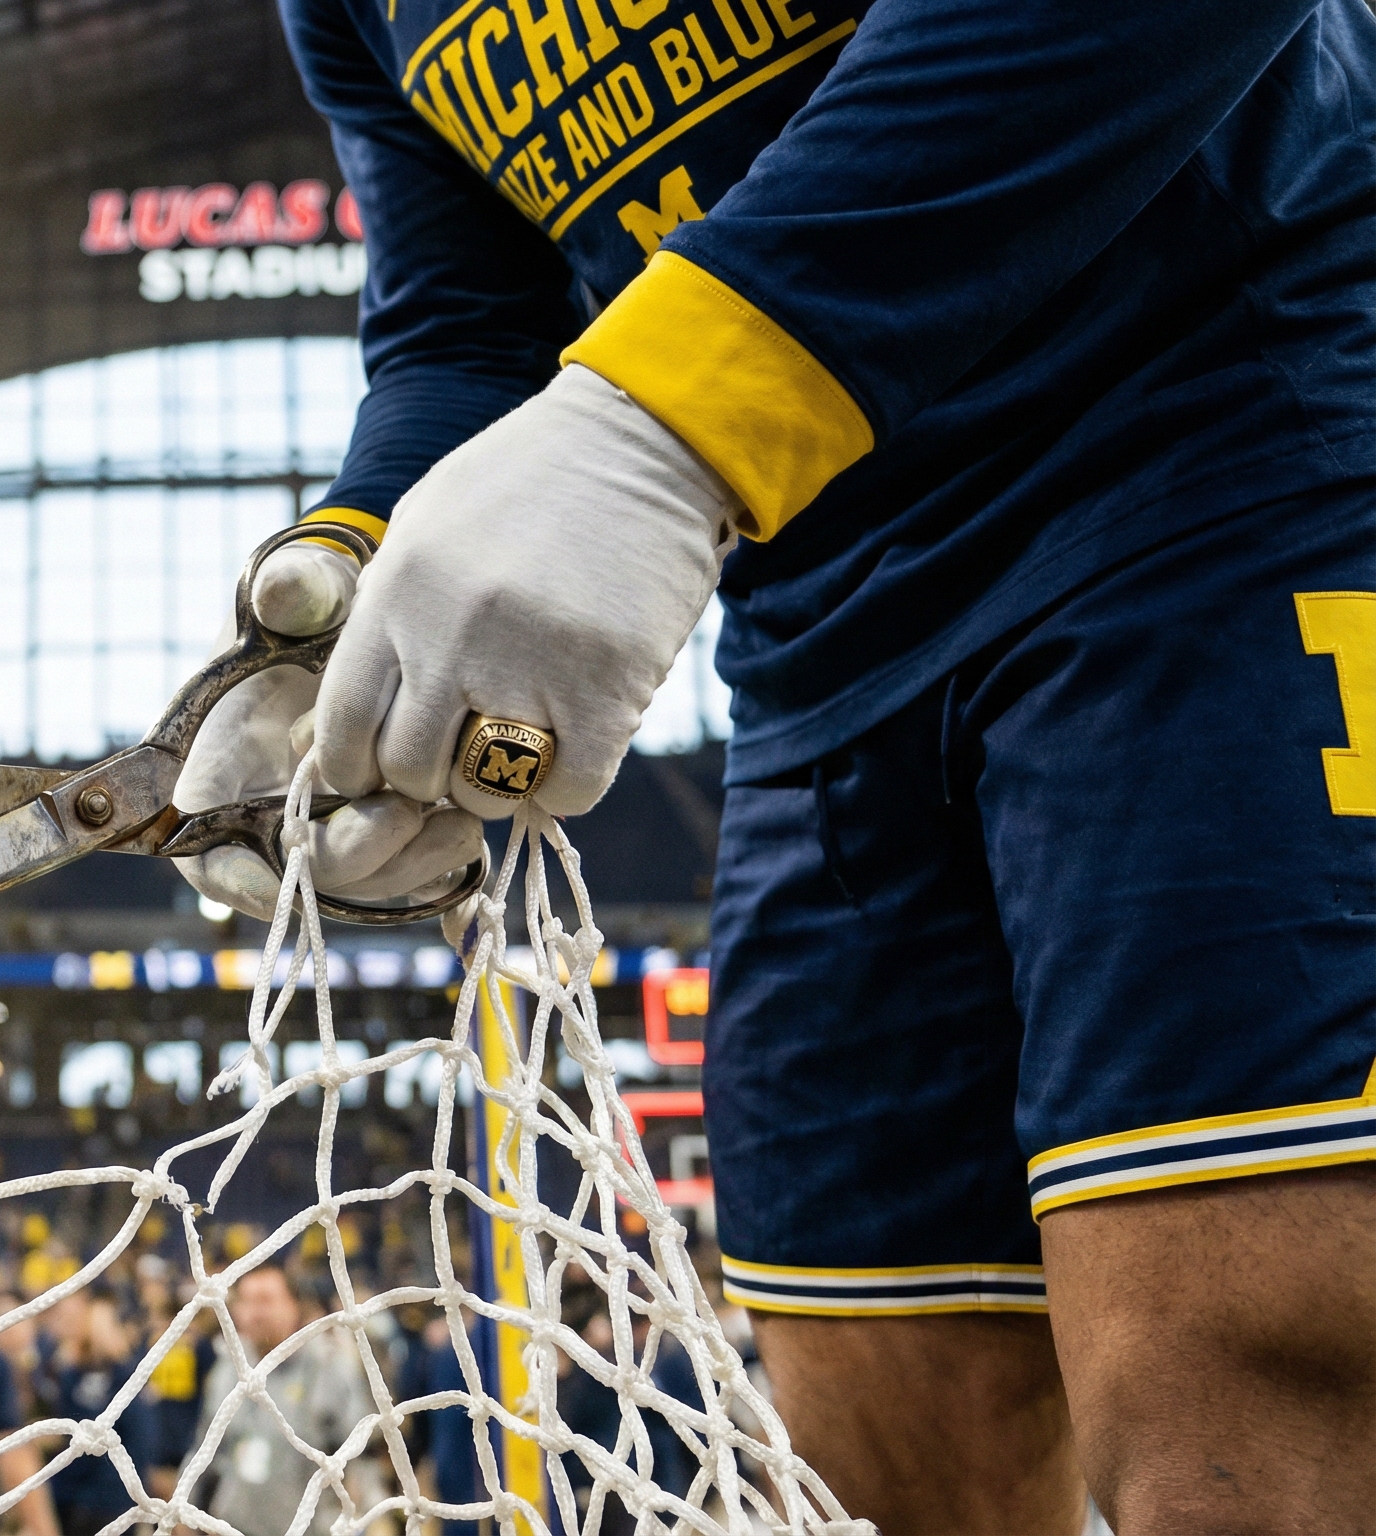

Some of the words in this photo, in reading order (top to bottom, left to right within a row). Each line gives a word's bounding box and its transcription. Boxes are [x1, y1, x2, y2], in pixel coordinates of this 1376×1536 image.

[411, 0, 670, 174] MICHI
[558, 62, 654, 181] AND
[649, 0, 817, 106] BLUE
[81, 183, 328, 254] LUCAS
[617, 164, 707, 268] M
[139, 244, 367, 302] STADIU
[479, 744, 539, 791] M
